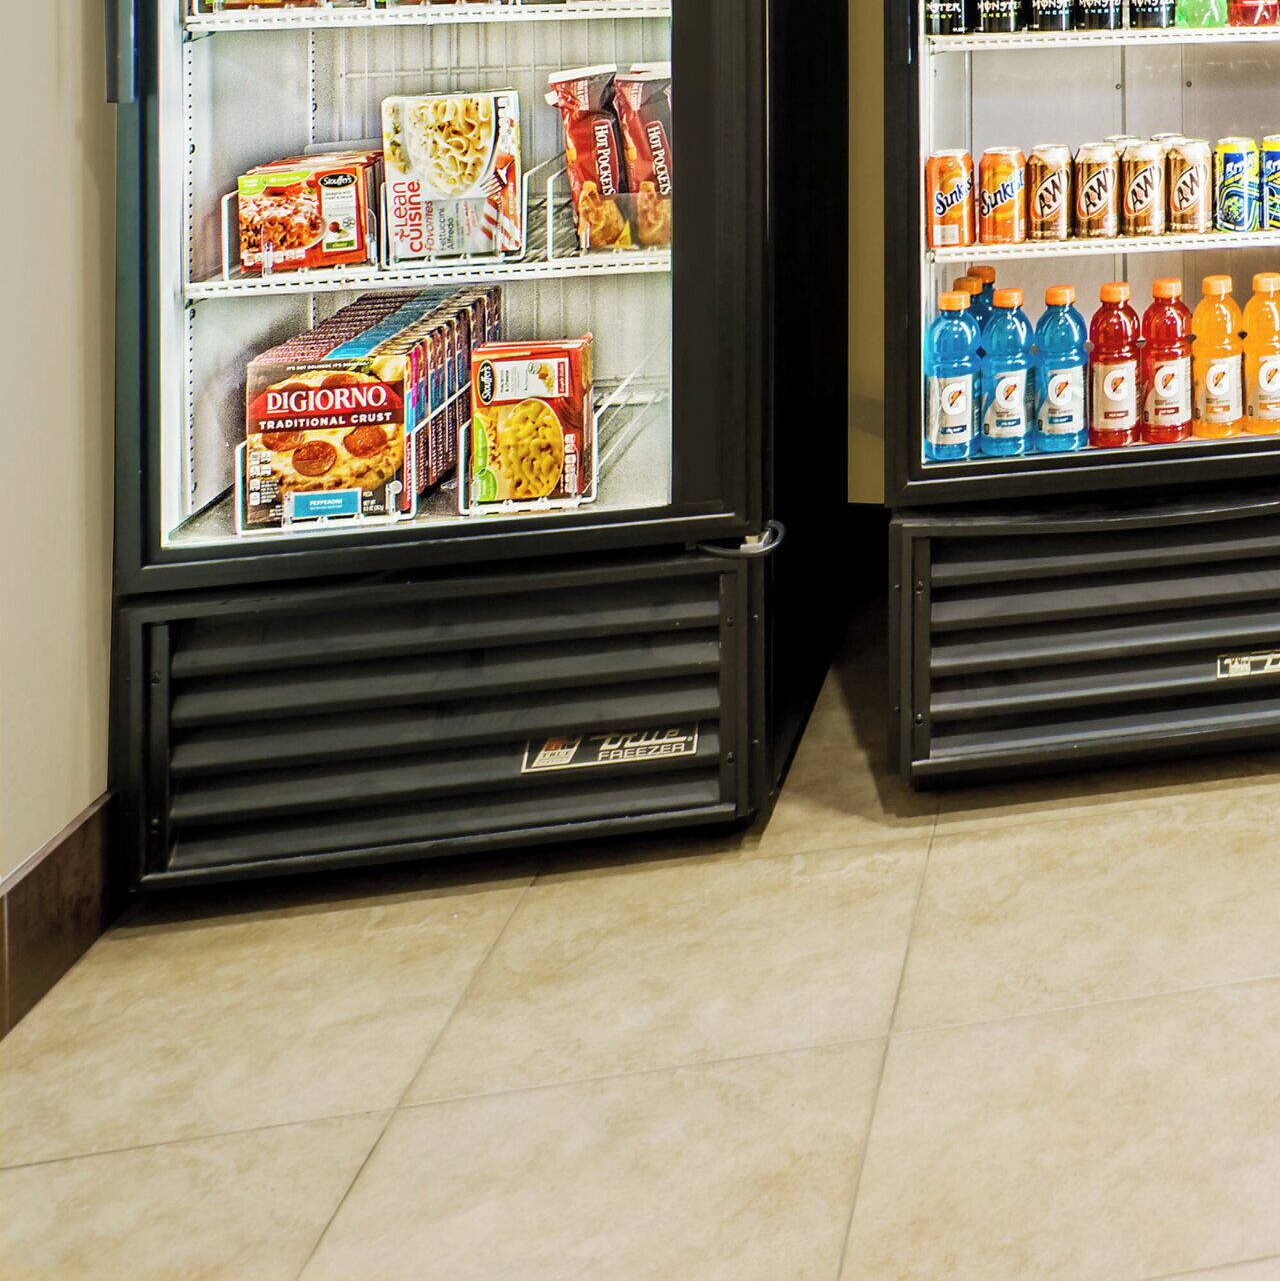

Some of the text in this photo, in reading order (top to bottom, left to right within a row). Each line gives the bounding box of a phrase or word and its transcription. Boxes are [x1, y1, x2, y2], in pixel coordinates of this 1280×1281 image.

[594, 124, 609, 148] HOT
[647, 125, 662, 149] HOT
[1037, 170, 1065, 218] A&W
[1084, 169, 1112, 217] A&W
[1130, 168, 1157, 213] A&W
[1176, 167, 1203, 211] A&W
[259, 411, 393, 431] TRADITIONAL CRUST
[598, 742, 686, 761] FREEZER
